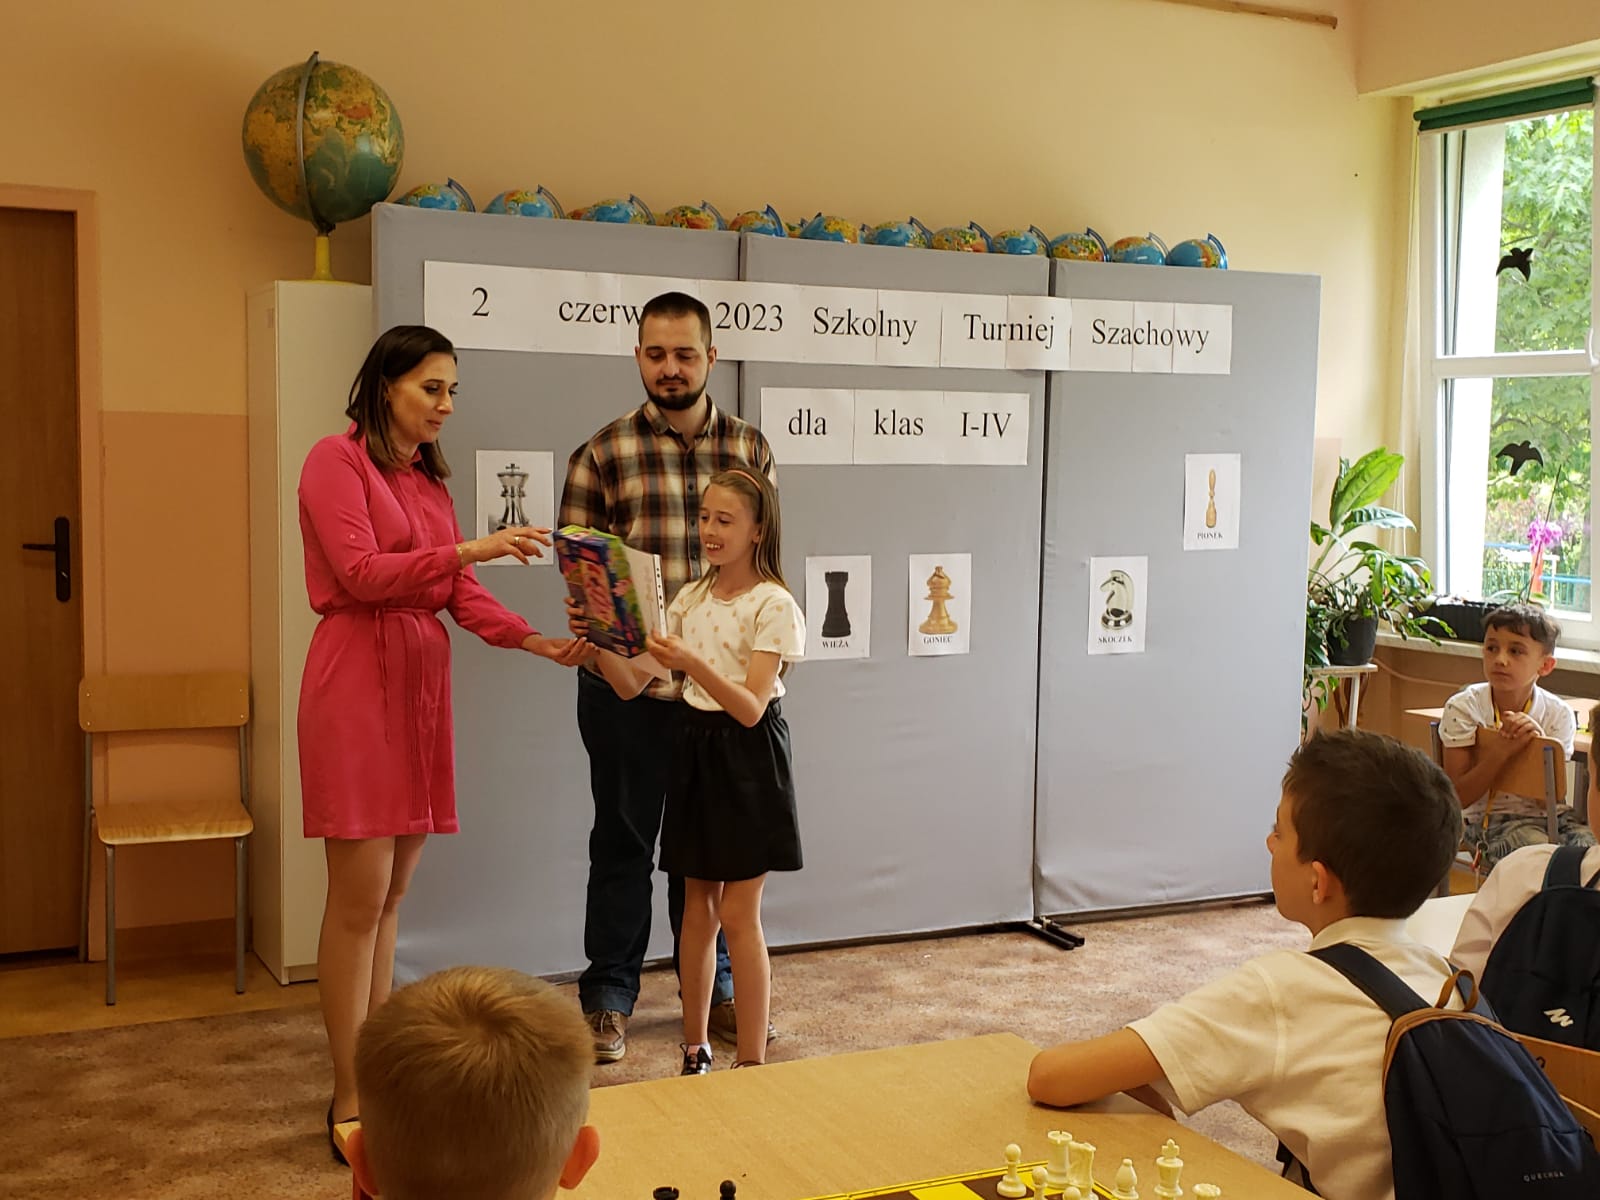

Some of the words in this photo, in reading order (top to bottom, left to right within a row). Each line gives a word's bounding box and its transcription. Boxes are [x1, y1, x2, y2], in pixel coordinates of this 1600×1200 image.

[472, 287, 490, 317] 2
[558, 300, 644, 326] czerw
[715, 301, 783, 332] 2023
[813, 307, 918, 344] Szkolny
[963, 313, 1055, 349] Turniej
[1091, 319, 1210, 353] Szachowy
[787, 408, 827, 436] dla
[873, 409, 924, 436] klas
[961, 411, 1012, 438] I-IV
[1196, 532, 1224, 541] PIONEK
[822, 639, 850, 649] WIEŻA
[922, 635, 953, 645] GONIEC
[1098, 634, 1133, 645] SKOCZEK
[1522, 1171, 1565, 1183] QUECHUA
